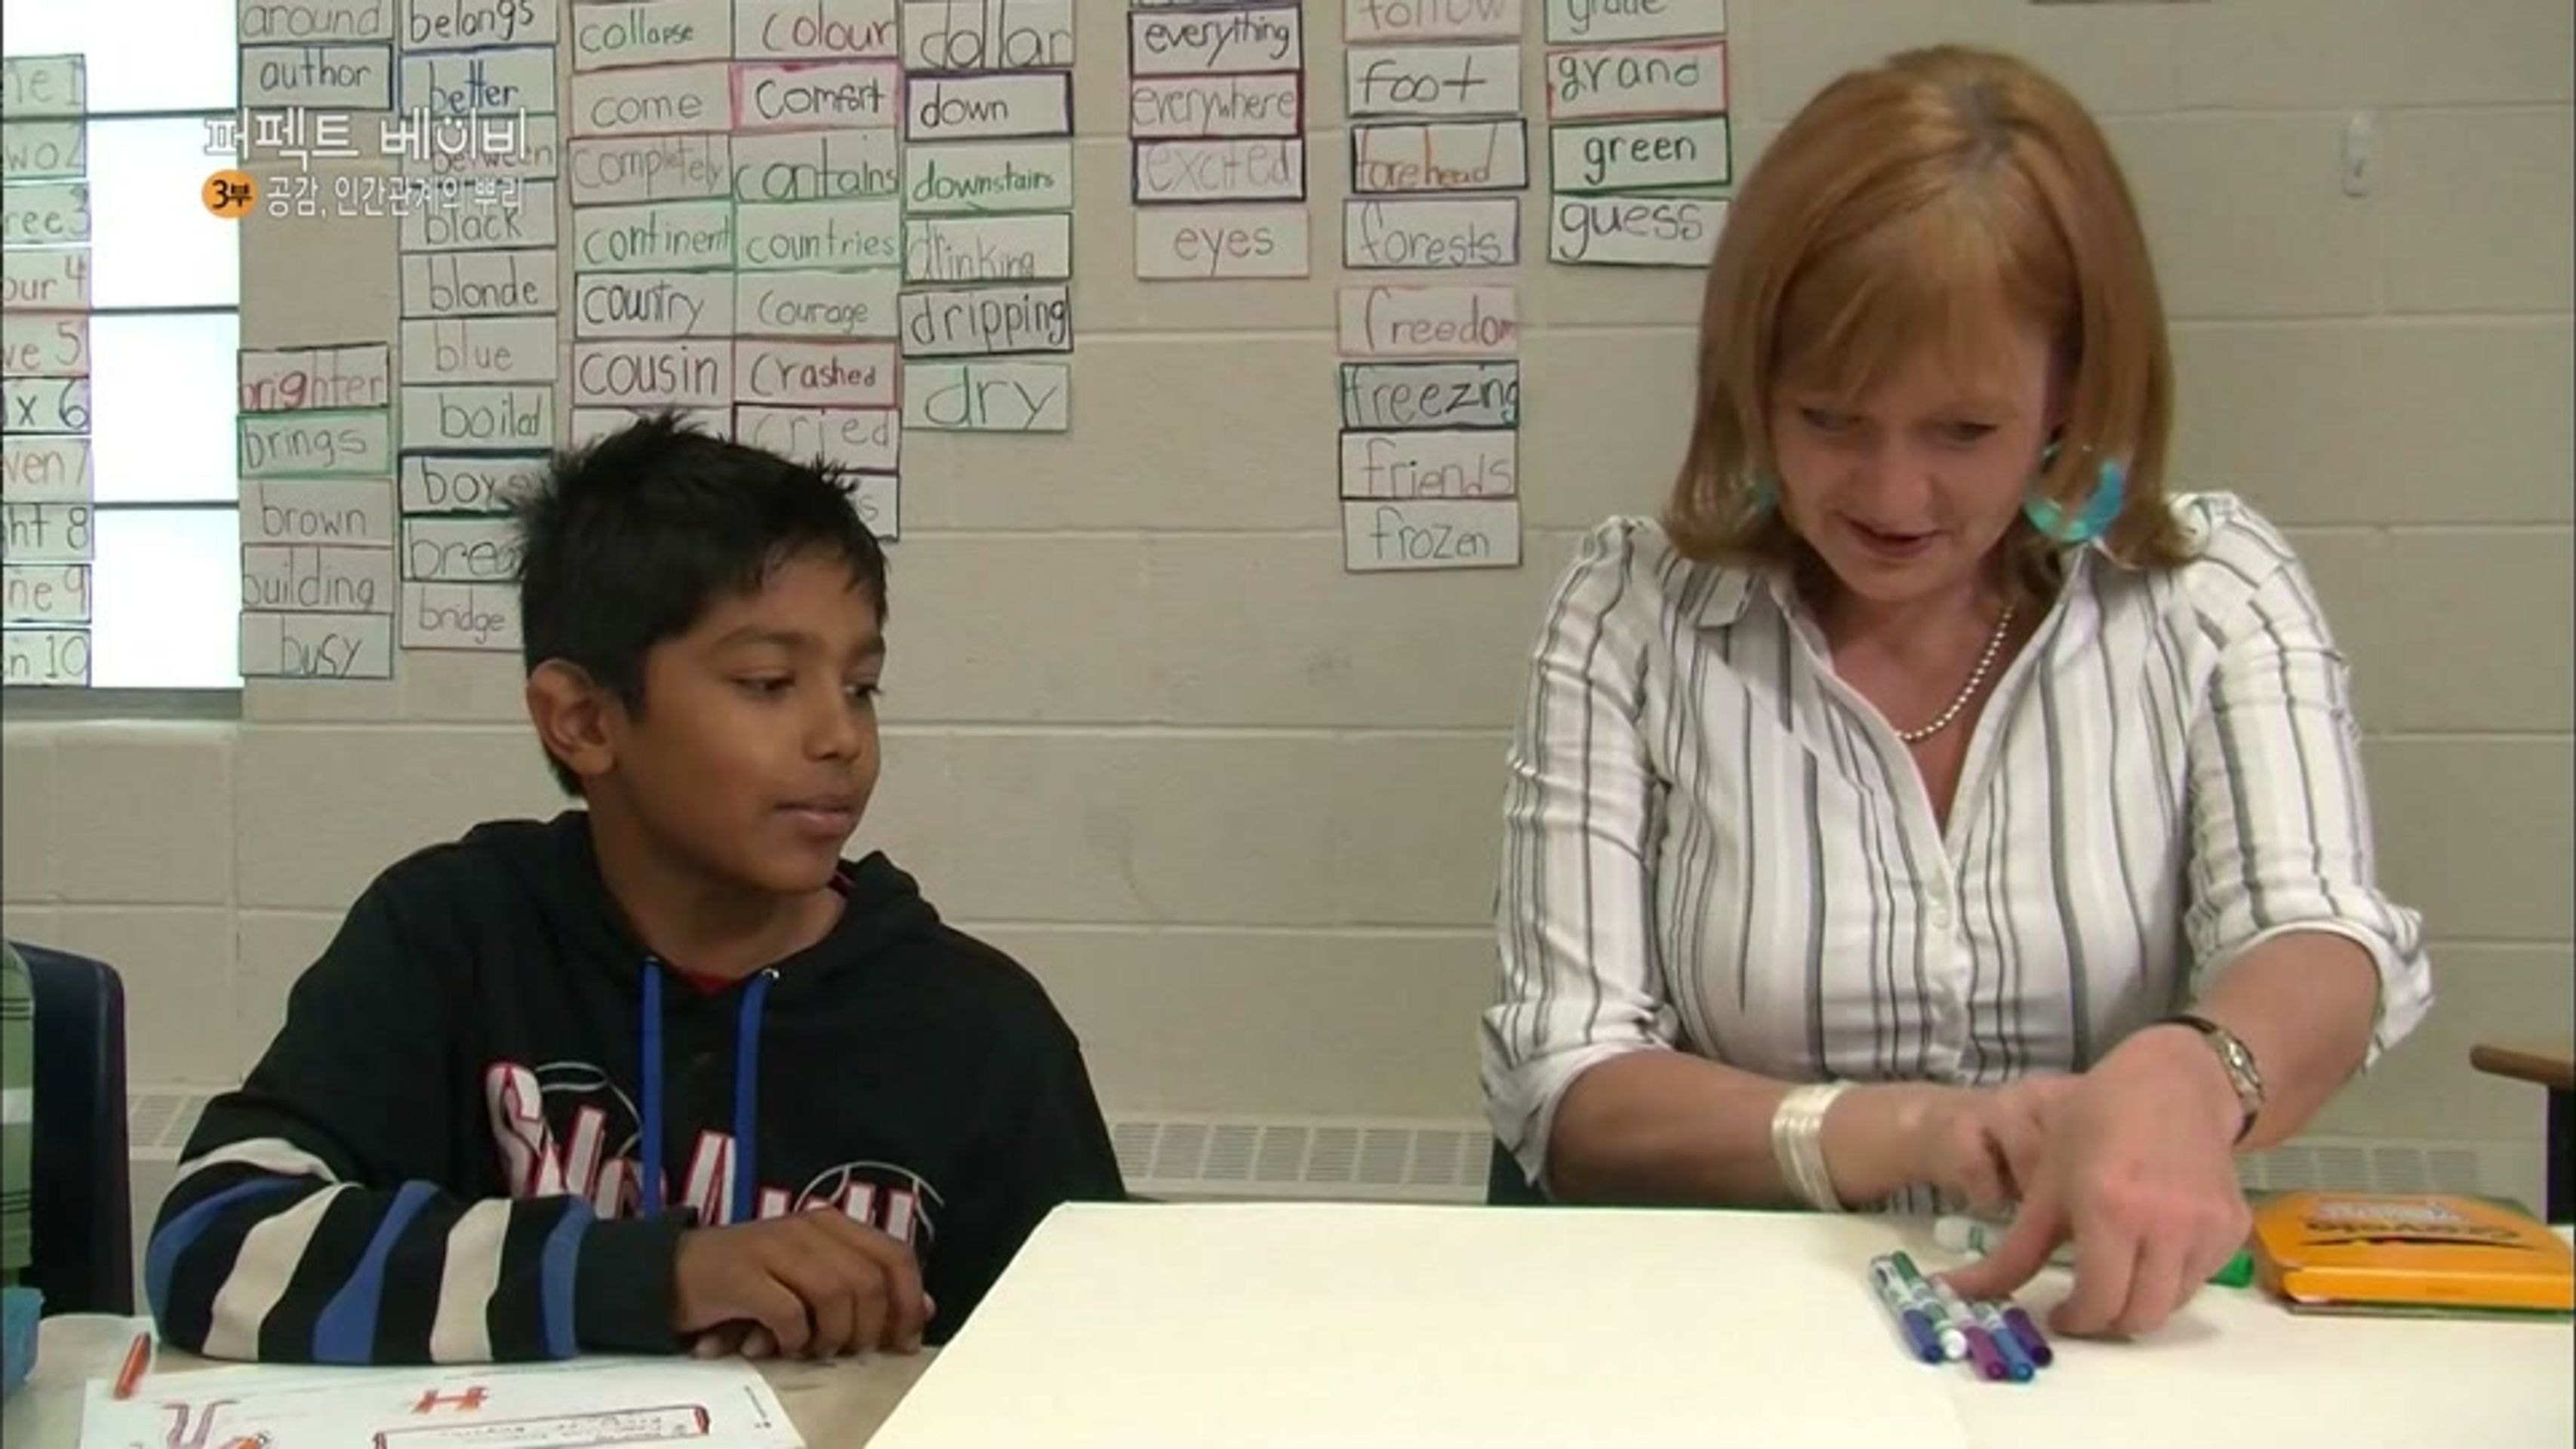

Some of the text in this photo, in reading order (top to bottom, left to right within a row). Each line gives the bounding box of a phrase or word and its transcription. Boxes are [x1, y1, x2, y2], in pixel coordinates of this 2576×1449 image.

[243, 0, 380, 36] around
[410, 0, 534, 42] belongs
[920, 0, 1072, 67] dollar
[1144, 11, 1289, 67] everything
[260, 46, 372, 91] author
[428, 59, 519, 113] better
[1356, 54, 1488, 105] foot
[1558, 56, 1699, 102] grand
[591, 94, 703, 128] come
[919, 82, 1008, 128] down
[1131, 78, 1296, 135] everywhere
[912, 159, 1054, 202] downstairs
[1583, 135, 1697, 186] green
[424, 198, 523, 245] black
[746, 217, 897, 264] countries
[1361, 199, 1503, 266] forests
[1558, 201, 1703, 261] guess
[1173, 227, 1276, 277] eyes
[426, 254, 538, 312] blonde
[55, 319, 82, 367] 5
[433, 321, 514, 371] blue
[911, 293, 1066, 352] dripping
[58, 379, 89, 429] 6
[924, 365, 1058, 430] dry
[244, 423, 368, 470] brings
[1362, 437, 1512, 497] friends
[66, 506, 89, 550] 8
[259, 480, 367, 537] brown
[1368, 505, 1491, 561] frozen
[419, 586, 506, 645] bridge
[45, 634, 88, 678] 10
[281, 616, 364, 678] busy
